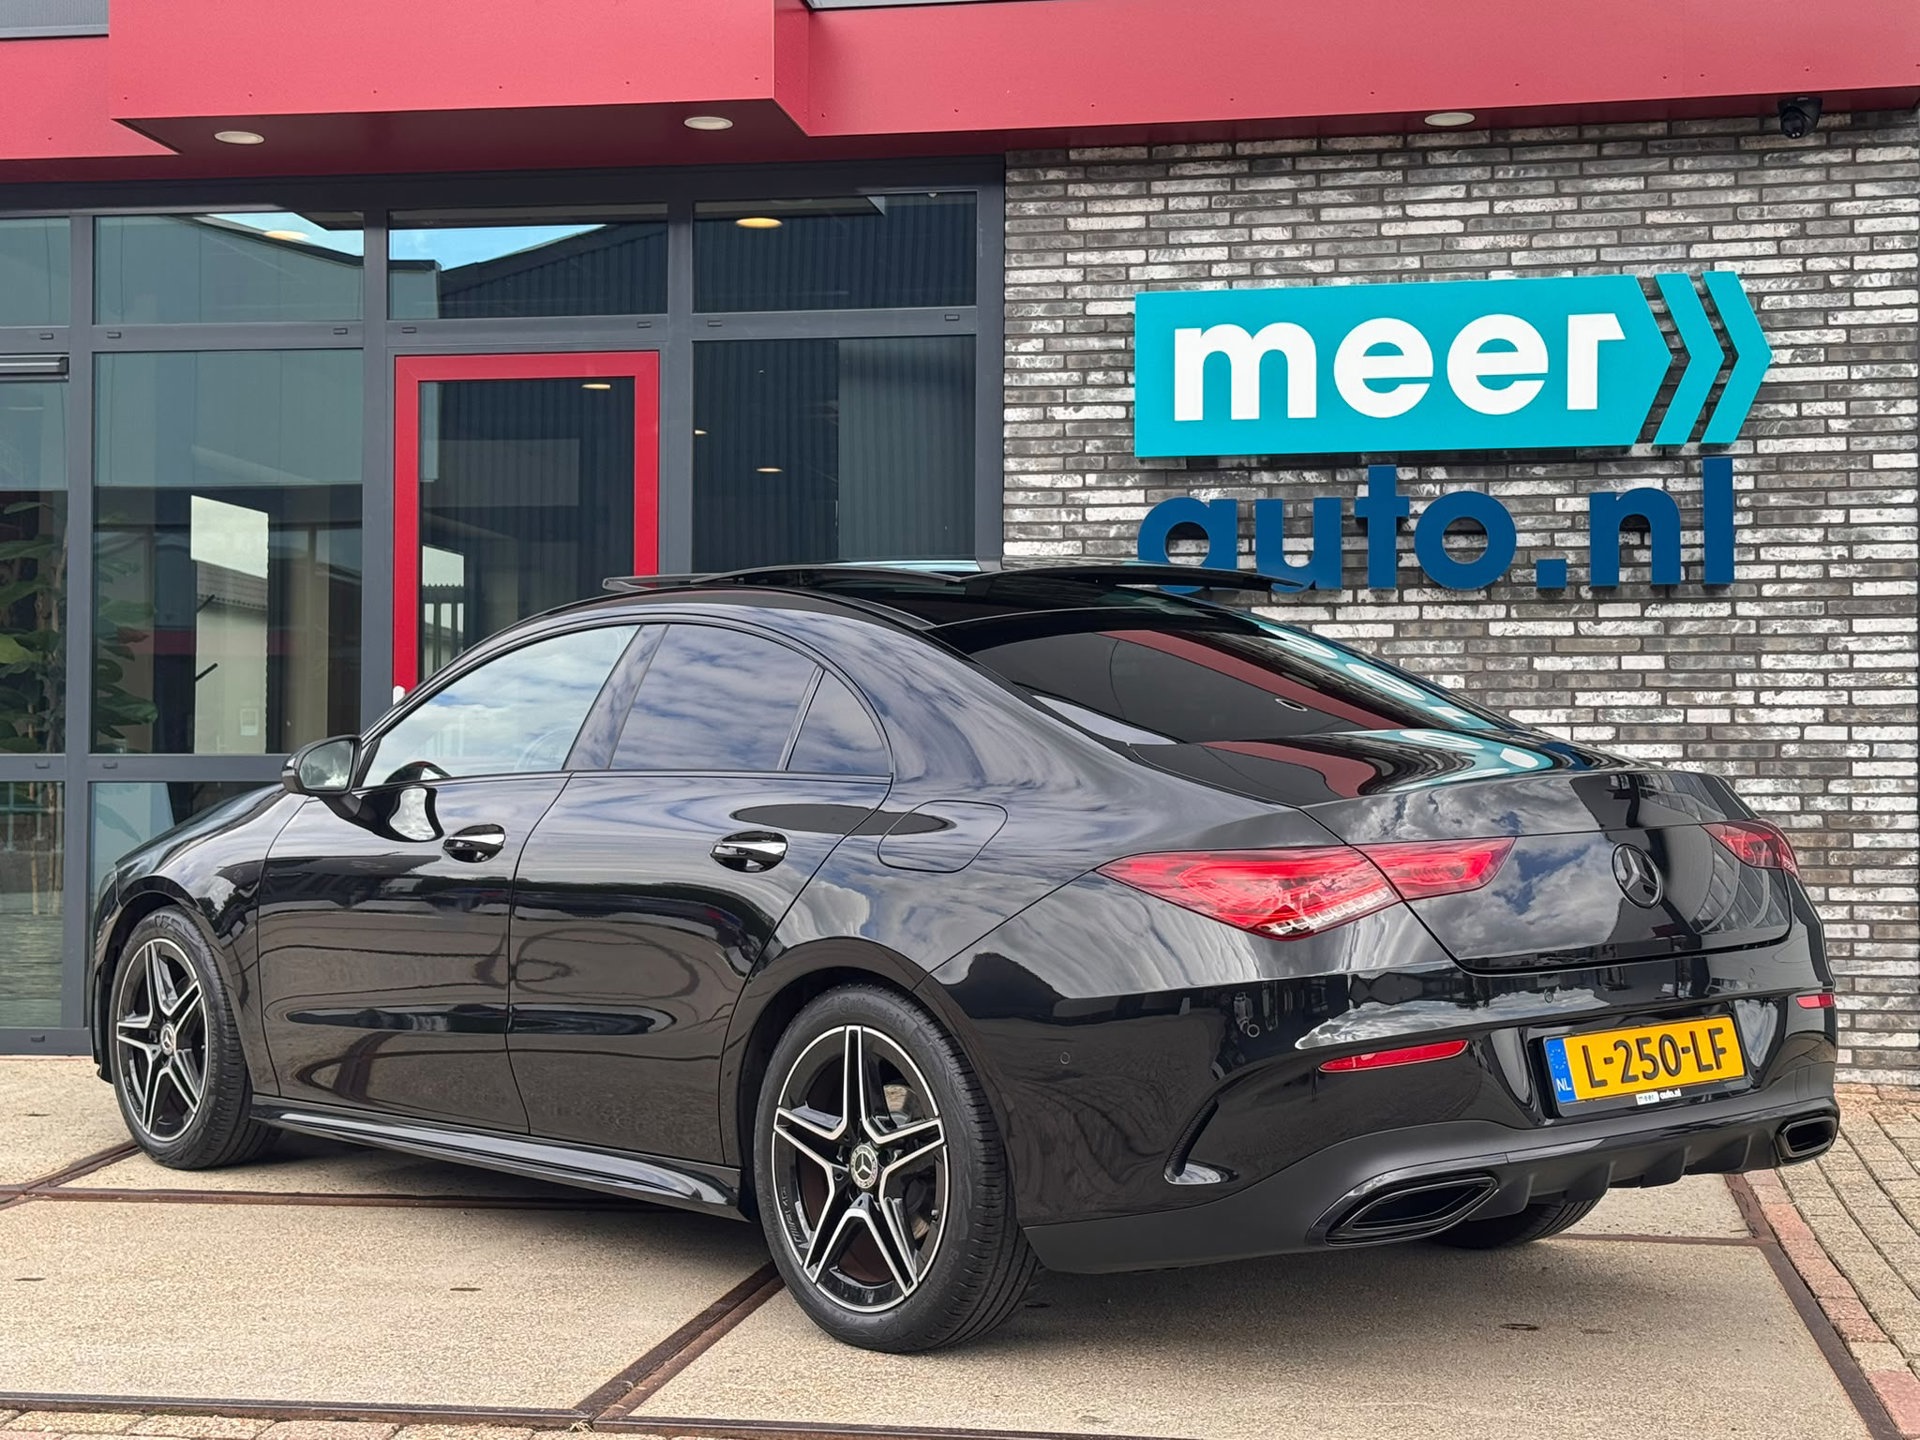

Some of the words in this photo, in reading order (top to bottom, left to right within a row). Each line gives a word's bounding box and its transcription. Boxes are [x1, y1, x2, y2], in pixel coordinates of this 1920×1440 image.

[1174, 313, 1626, 421] meer
[1137, 456, 1735, 594] auto.nl
[1555, 1078, 1572, 1092] NL
[1582, 1027, 1727, 1088] L-250-LF
